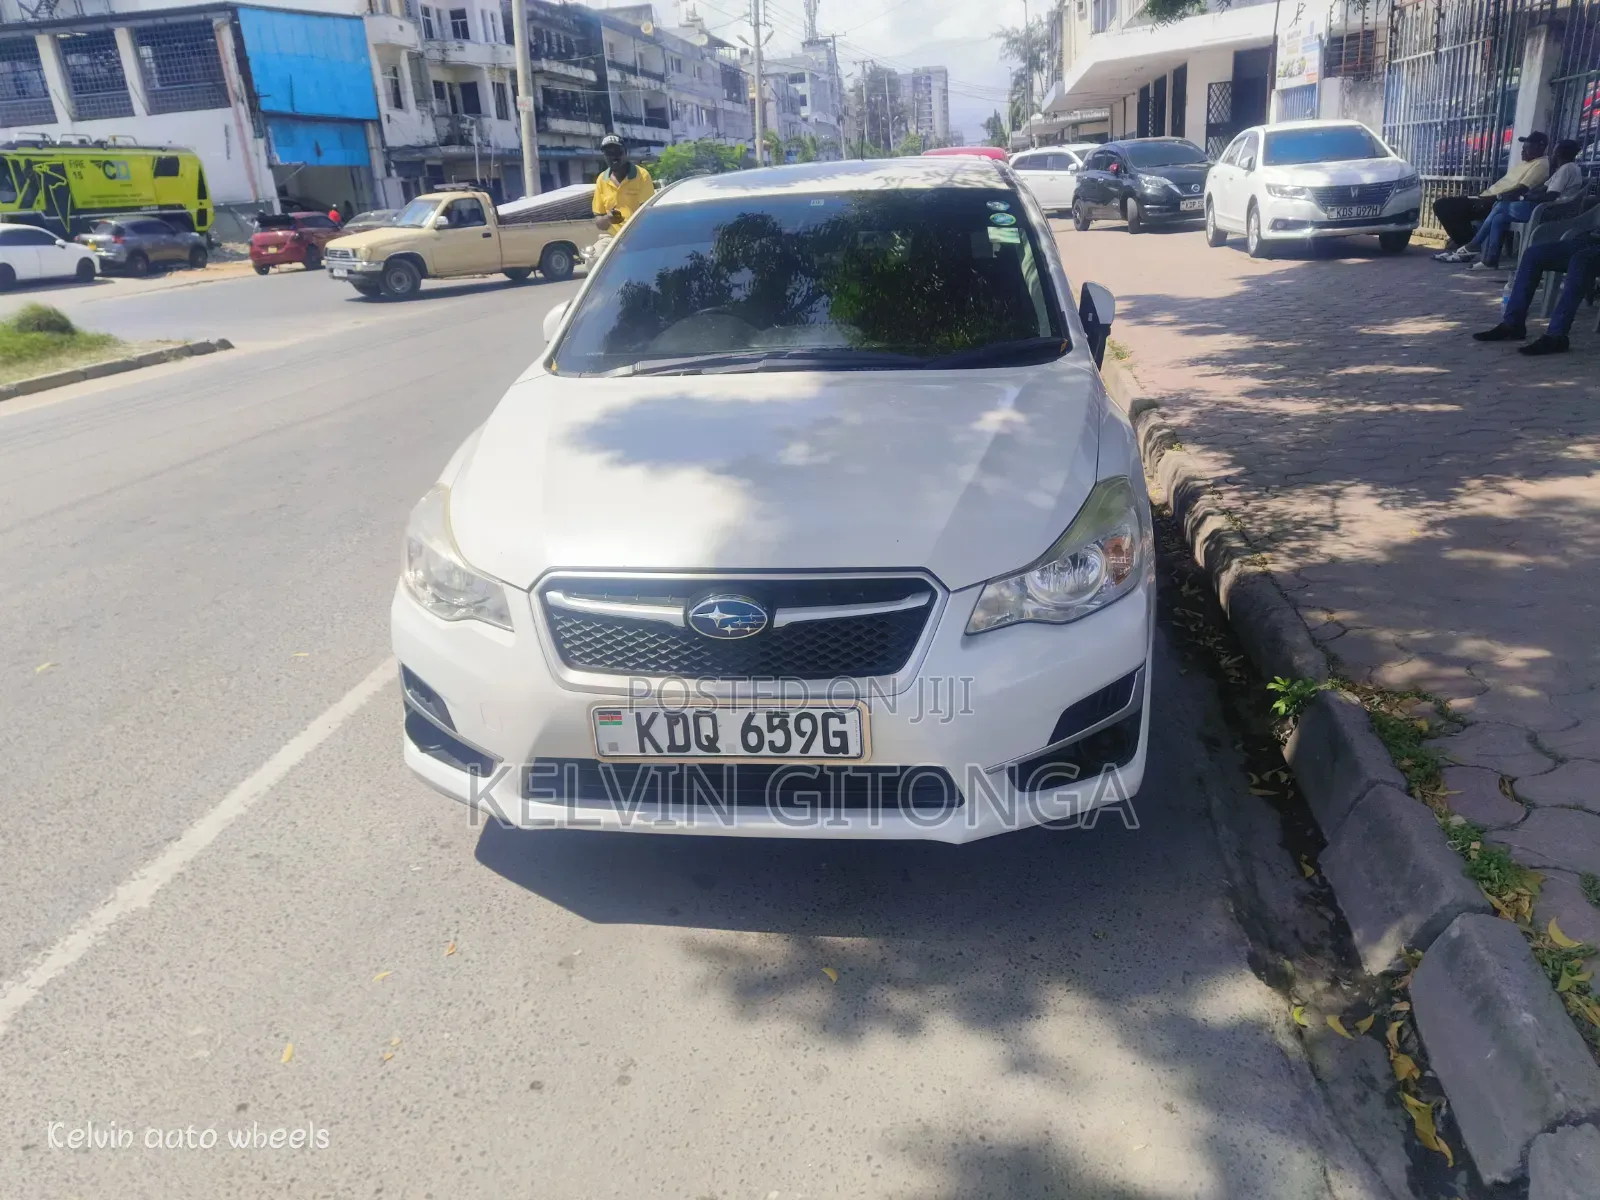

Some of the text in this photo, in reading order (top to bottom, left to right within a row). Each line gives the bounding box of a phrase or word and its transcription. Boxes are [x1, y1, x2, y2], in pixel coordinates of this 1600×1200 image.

[68, 159, 86, 169] FIRE
[1336, 207, 1353, 218] KDS
[634, 711, 721, 753] KDQ
[740, 711, 849, 755] 659G
